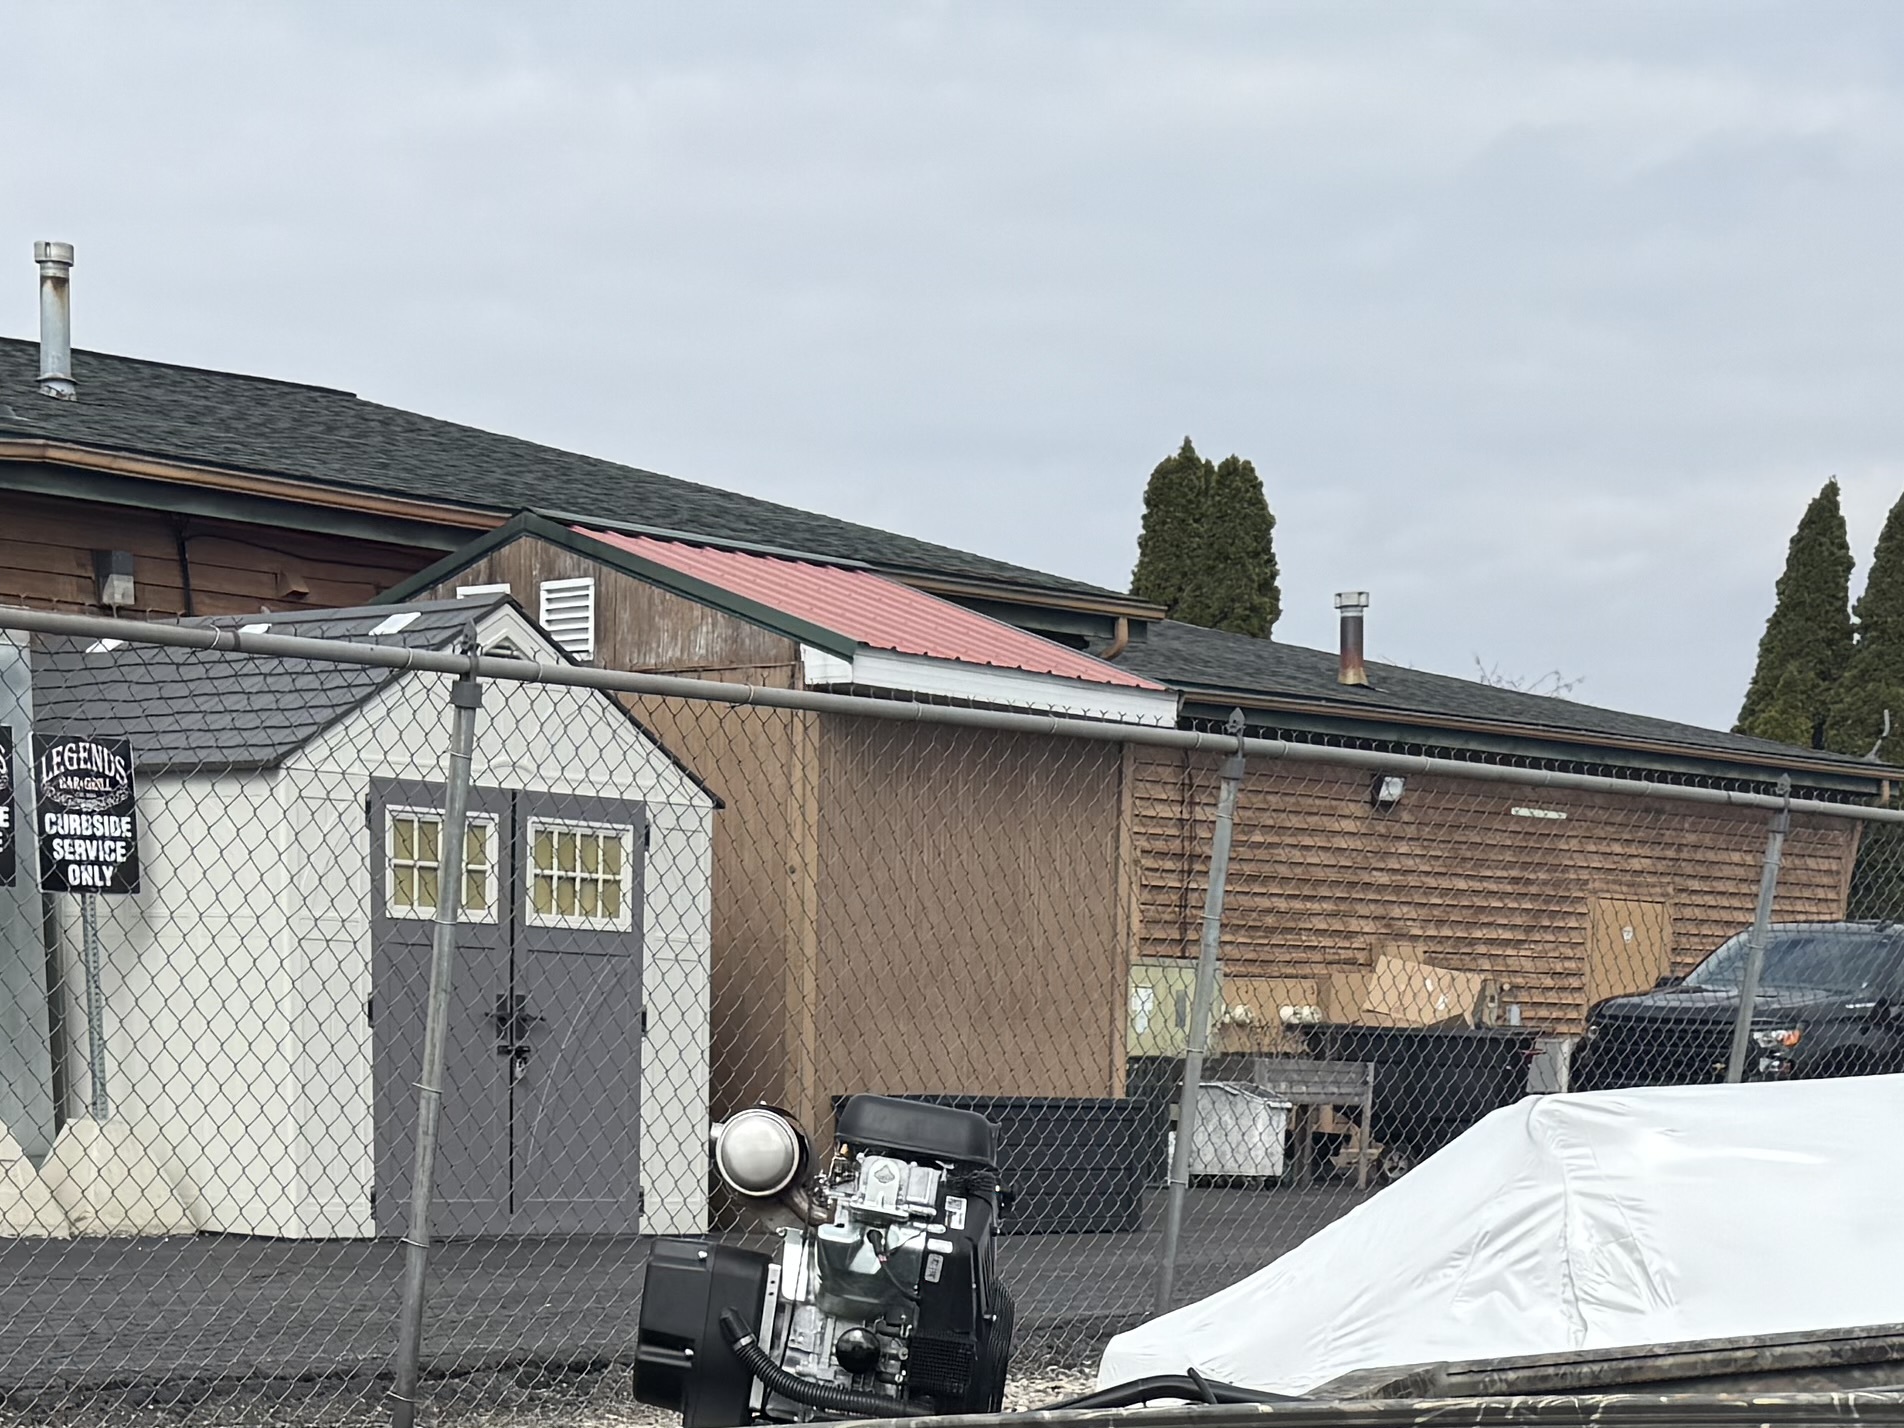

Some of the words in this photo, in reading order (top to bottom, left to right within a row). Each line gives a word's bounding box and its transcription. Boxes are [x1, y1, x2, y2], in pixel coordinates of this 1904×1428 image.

[41, 742, 128, 785] LEGENDS
[45, 813, 132, 838] CURBSIDE
[52, 838, 127, 863] SERVICE
[67, 864, 114, 887] ONLY
